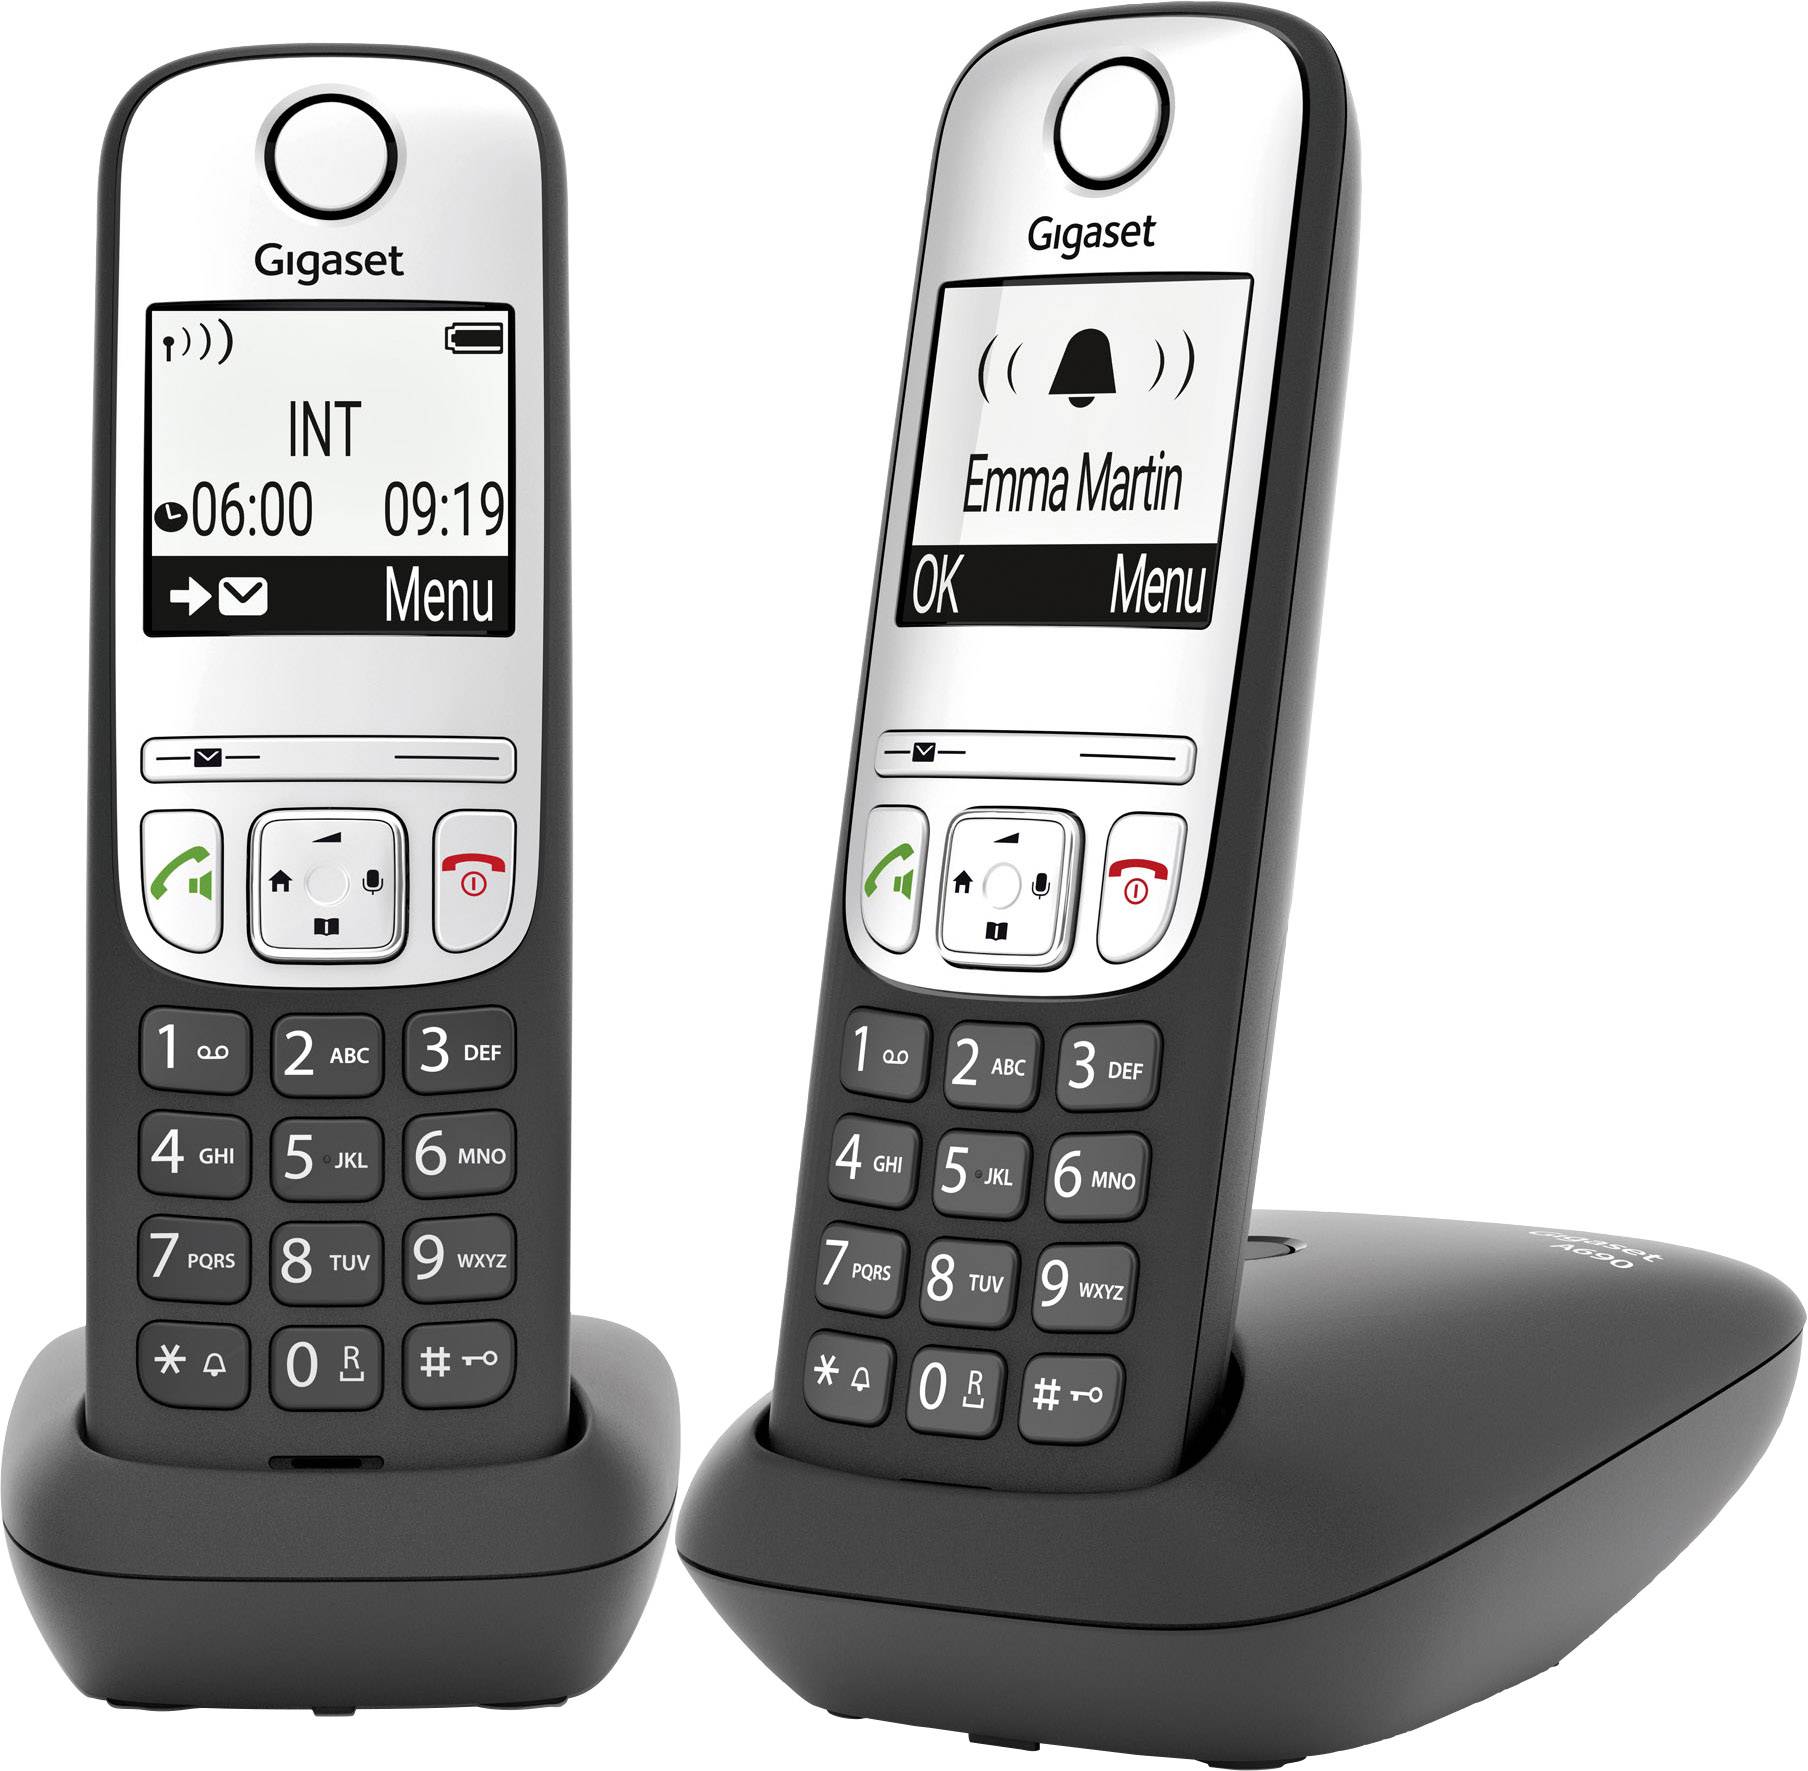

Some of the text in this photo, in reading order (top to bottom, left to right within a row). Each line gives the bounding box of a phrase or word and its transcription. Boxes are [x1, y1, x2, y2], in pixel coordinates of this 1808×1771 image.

[1029, 216, 1156, 260] Gigaset
[255, 243, 404, 286] Gigaset
[291, 401, 361, 456] INT
[963, 450, 1182, 512] Emma Martin
[193, 481, 312, 536] 06:00
[385, 481, 504, 536] 09:19
[387, 566, 492, 622] Menu
[913, 554, 964, 613] OK
[1111, 553, 1206, 613] Menu
[159, 1024, 174, 1068] 1
[285, 1030, 369, 1075] 2 ABC
[421, 1027, 501, 1072] 3 DEF
[856, 1026, 867, 1071] 1
[952, 1038, 1026, 1085] 2 ABC
[1069, 1041, 1143, 1089] 3 DEF
[151, 1129, 233, 1173] 4 GHI
[285, 1135, 368, 1179] 5 JKL
[416, 1130, 506, 1175] 6 MNO
[836, 1134, 902, 1179] 4 GHI
[941, 1146, 1013, 1193] 5 JKL
[1054, 1150, 1135, 1198] 6 MNO
[151, 1233, 235, 1277] 7 PQRS
[281, 1238, 370, 1283] 8 TUV
[414, 1235, 506, 1280] 9 WXYZ
[823, 1239, 891, 1285] 7 PQRS
[927, 1254, 1004, 1301] 8 TUV
[1549, 1243, 1634, 1269] A690
[1041, 1259, 1124, 1307] 9 WXYZ
[287, 1342, 359, 1387] 0 R
[421, 1347, 450, 1377] #
[920, 1362, 982, 1410] 0 R
[1033, 1378, 1061, 1410] #
